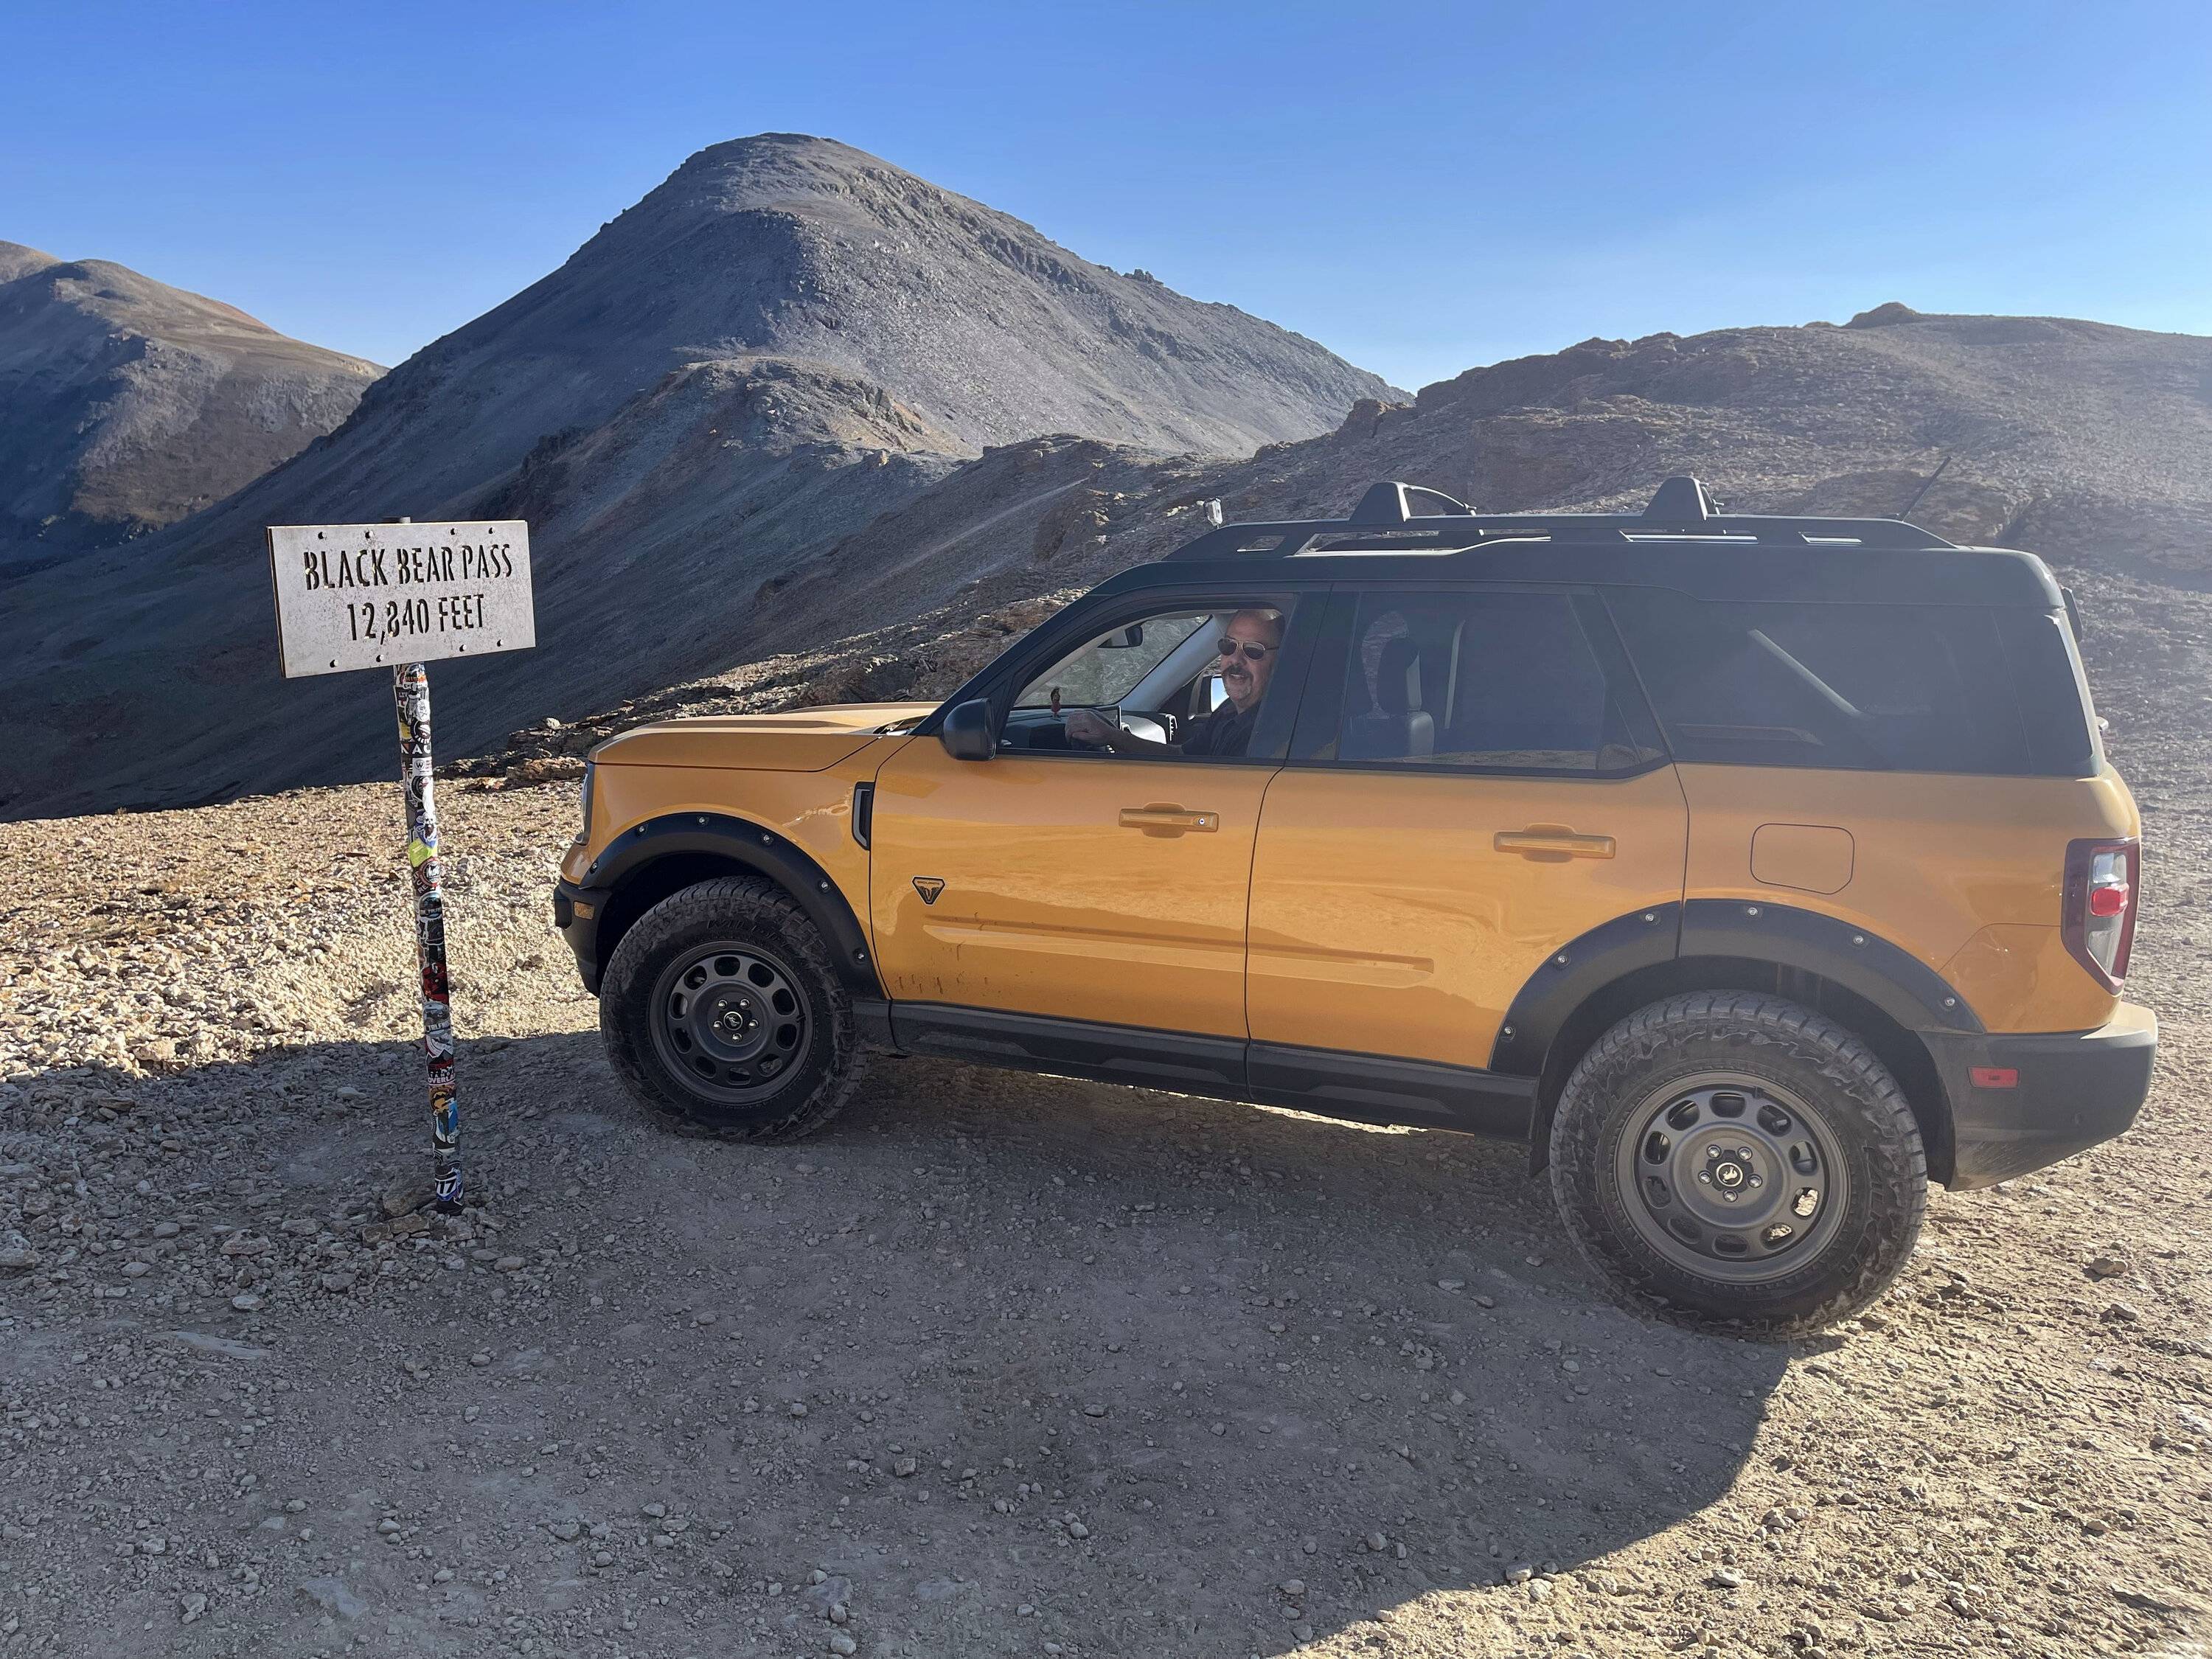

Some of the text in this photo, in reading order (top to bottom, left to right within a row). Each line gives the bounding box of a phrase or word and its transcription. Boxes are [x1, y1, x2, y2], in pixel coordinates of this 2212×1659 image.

[304, 543, 512, 591] BLACK BEAR PASS
[347, 594, 484, 645] 12,840 FEET
